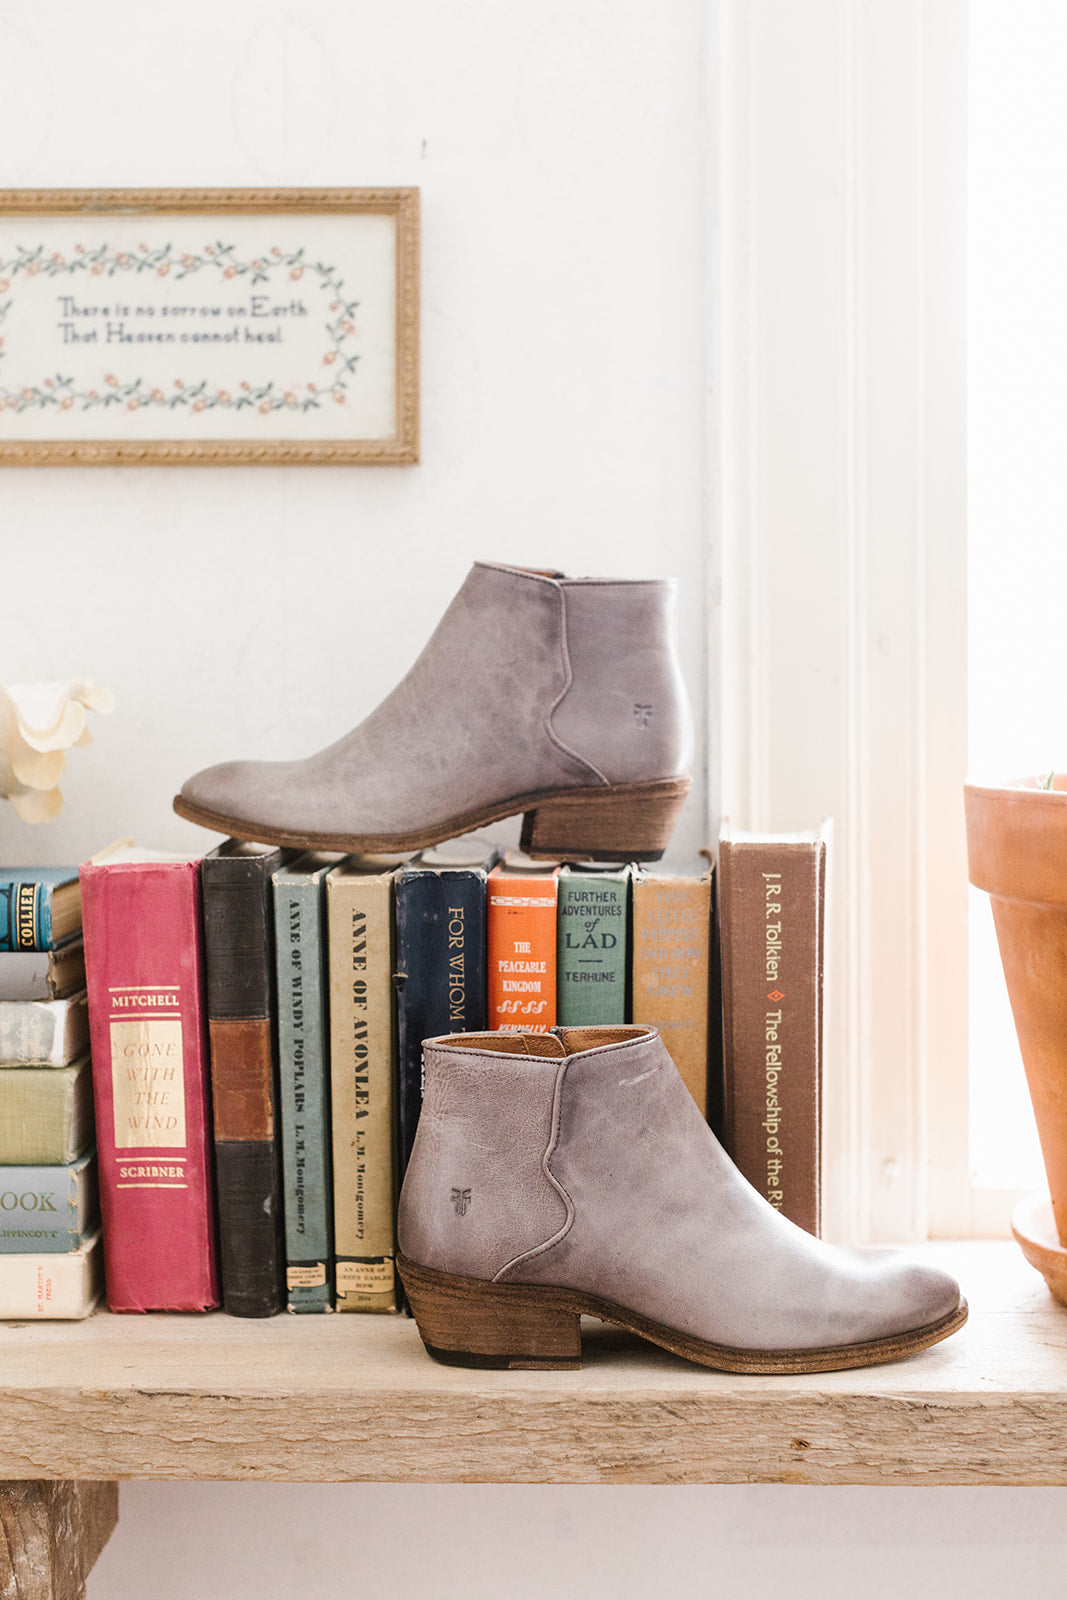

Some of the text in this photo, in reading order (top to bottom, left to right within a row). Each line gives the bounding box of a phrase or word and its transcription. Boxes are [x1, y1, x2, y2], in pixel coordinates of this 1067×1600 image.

[57, 296, 307, 317] There is no sorrow on Earth
[57, 322, 97, 343] That
[106, 322, 175, 343] Heaven
[180, 325, 239, 343] cannot
[568, 891, 617, 903] FURTHER
[656, 891, 690, 904] FIVE
[21, 887, 34, 946] COLLIER
[561, 905, 622, 917] ADVENTURES
[649, 909, 698, 924] LITTLE
[290, 900, 302, 943] ANNE
[448, 906, 465, 949] FOR
[584, 918, 600, 933] of
[352, 908, 367, 971] ANNE
[565, 932, 618, 949] LAD
[642, 928, 701, 942] PEPPERS
[513, 941, 531, 954] THE
[639, 946, 703, 960] AND HOW
[765, 921, 782, 981] Tolkien
[290, 949, 302, 971] OF
[498, 960, 547, 974] PEACEABLE
[565, 971, 616, 983] TERHUNE
[651, 966, 691, 979] THEY
[449, 953, 466, 1021] WHOM
[502, 980, 542, 993] KINGDOM
[648, 984, 694, 997] GREW
[112, 995, 180, 1007] MITCHELL
[291, 976, 303, 1032] WINDY
[353, 980, 367, 1011] OF
[766, 1009, 782, 1041] The
[123, 1043, 176, 1058] GONE
[126, 1067, 175, 1081] WITH
[293, 1039, 305, 1113] POPLARS
[353, 1016, 369, 1120] AVONLEA
[761, 1044, 782, 1134] Fellowship
[135, 1091, 171, 1105] THE
[127, 1116, 178, 1130] WIND
[766, 1137, 783, 1155] of
[120, 1166, 185, 1178] SCRIBNER
[767, 1159, 783, 1186] the
[295, 1158, 307, 1236] Montgomery
[355, 1164, 367, 1241] Montgomery
